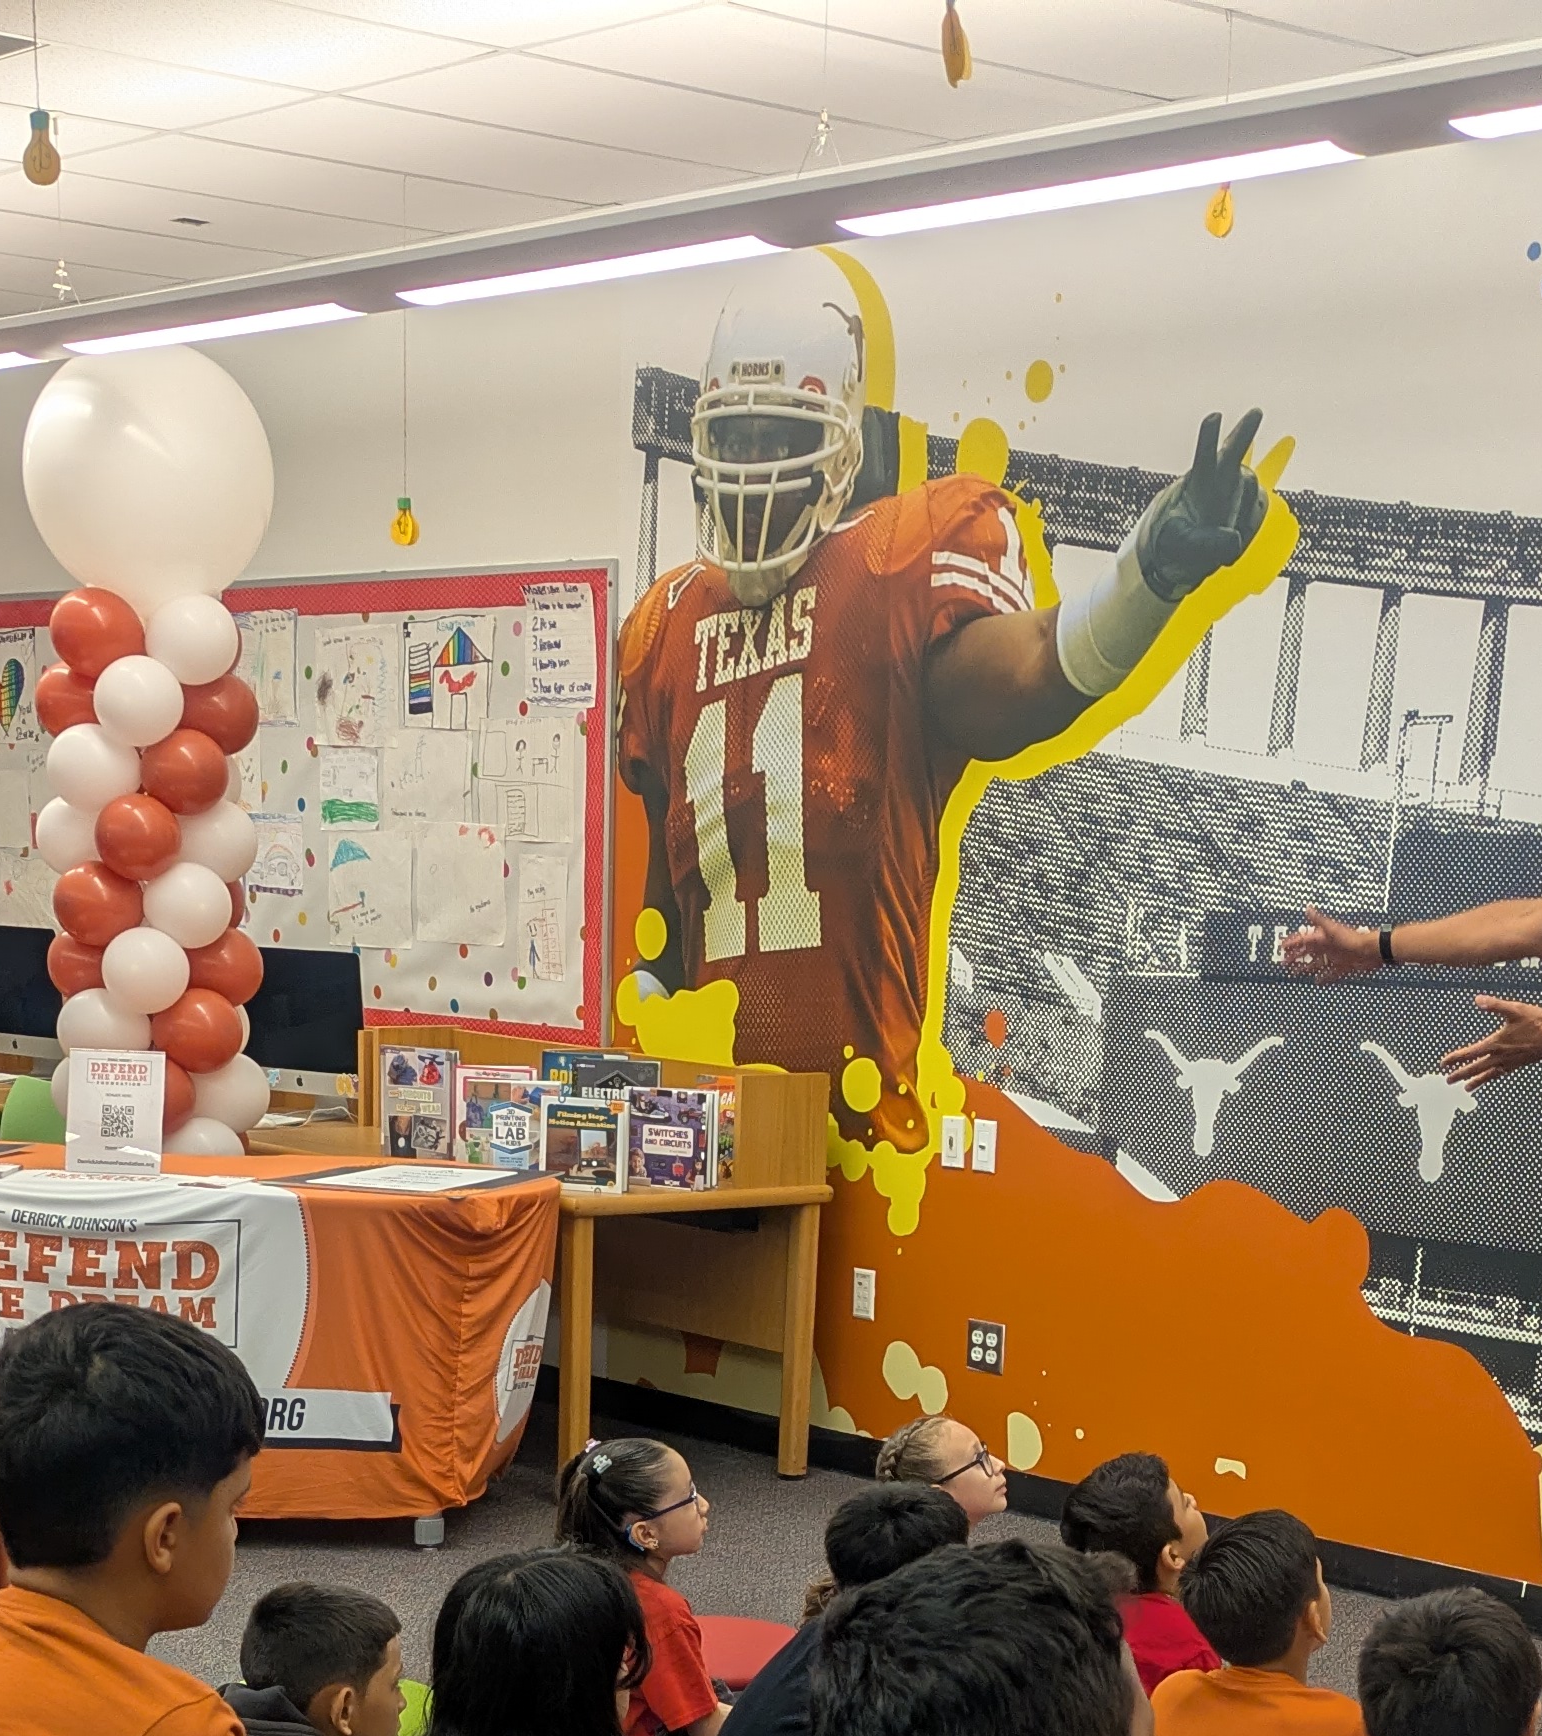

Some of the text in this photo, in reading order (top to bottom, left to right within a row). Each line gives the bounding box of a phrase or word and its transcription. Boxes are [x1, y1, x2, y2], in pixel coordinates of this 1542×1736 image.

[741, 362, 769, 376] HORNS
[694, 585, 816, 694] TEXAS
[684, 672, 822, 963] 11
[90, 1062, 148, 1075] DEFEND
[495, 1126, 526, 1141] LAB
[647, 1127, 689, 1139] SWITCHES
[659, 1139, 691, 1149] CIRCUITS
[11, 1208, 137, 1233] DERRICK JOHNSON'S
